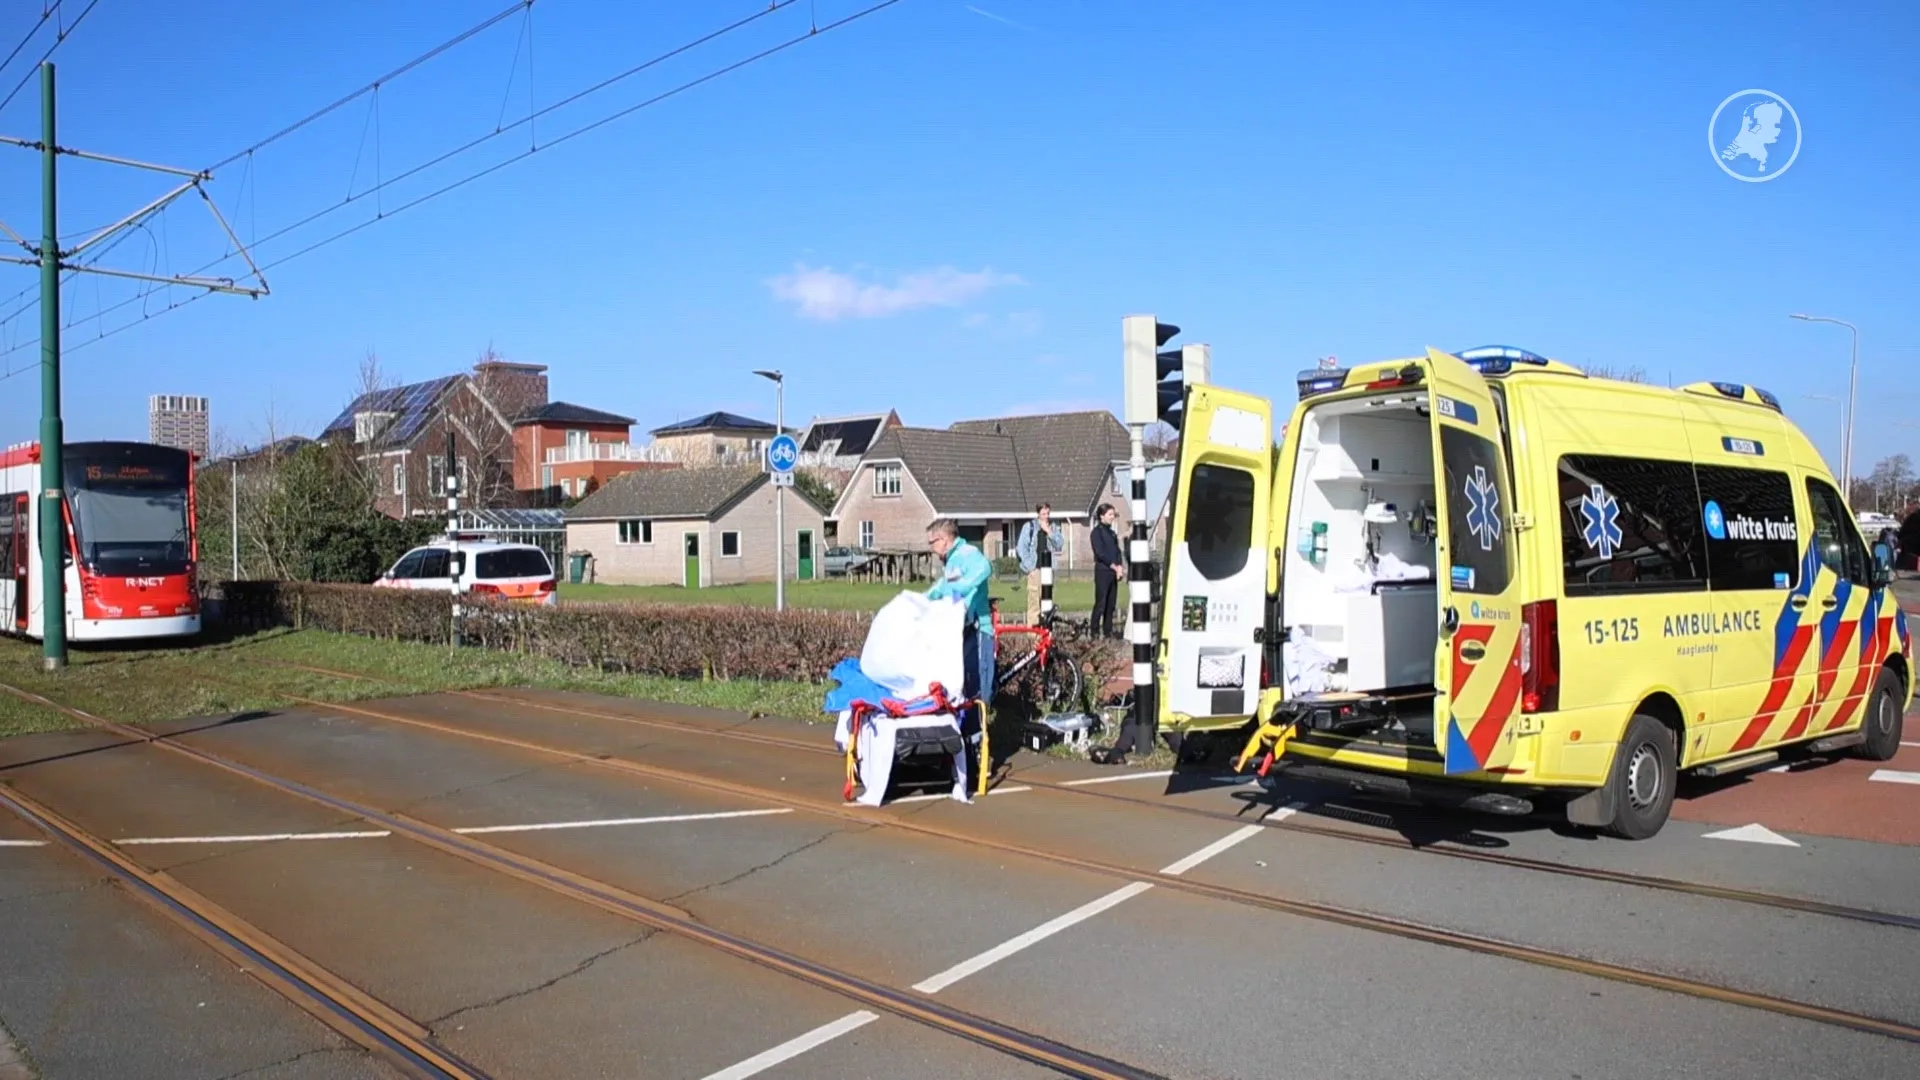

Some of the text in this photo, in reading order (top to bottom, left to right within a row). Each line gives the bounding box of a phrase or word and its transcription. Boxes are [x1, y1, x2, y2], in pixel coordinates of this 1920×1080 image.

[87, 465, 101, 480] 15
[1726, 513, 1797, 540] witte kruis
[1584, 610, 1761, 645] 15-125 AMBULANCE
[1676, 643, 1719, 657] Haaglanden
